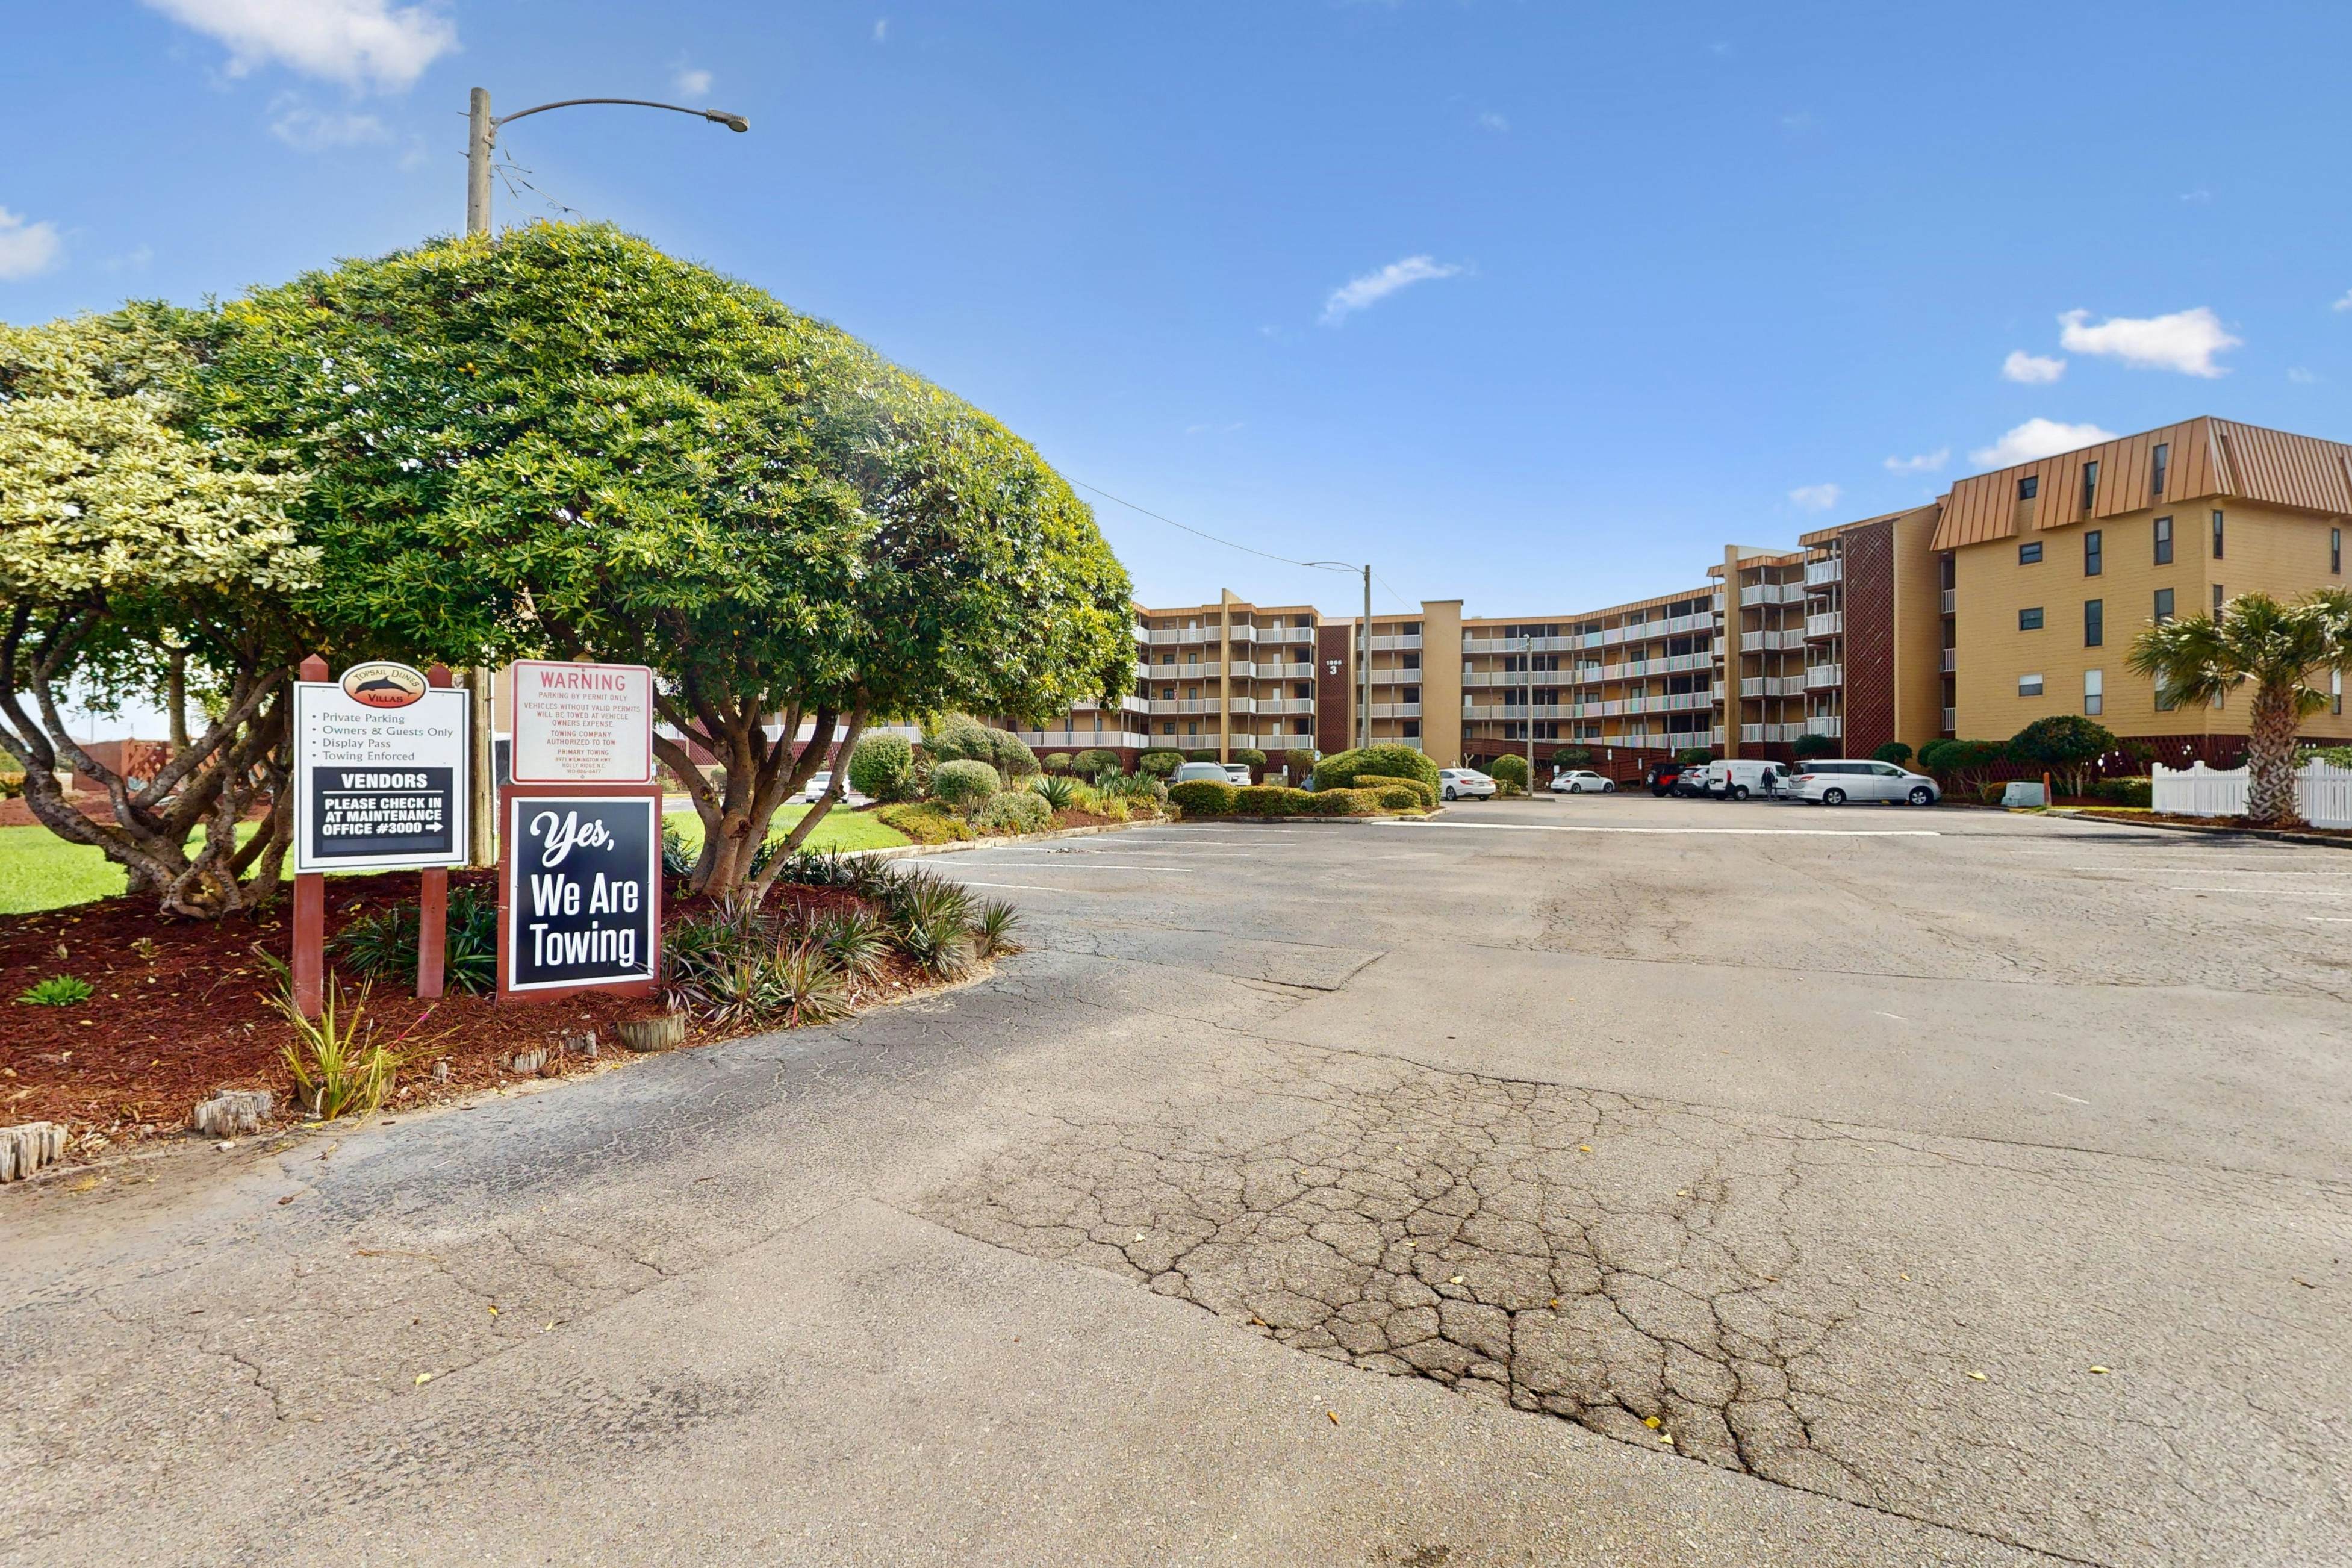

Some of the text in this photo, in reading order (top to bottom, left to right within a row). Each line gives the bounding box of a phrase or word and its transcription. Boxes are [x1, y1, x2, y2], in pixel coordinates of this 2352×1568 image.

[1330, 666, 1337, 674] 3
[353, 669, 419, 687] TOPSAIL DUNES
[541, 671, 625, 691] WARNING
[368, 694, 403, 703] VILLAS
[323, 712, 405, 724] Private Parking
[323, 725, 453, 738] Owners & Guests Only
[323, 739, 391, 749] Display Pass
[322, 751, 414, 762] Towing Enforced
[341, 773, 428, 788] VENDORS
[325, 797, 442, 810] PLEASE CHECK IN
[325, 810, 442, 823] AT MAINTENANCE
[322, 822, 422, 835] OFFICE #3000
[530, 811, 614, 868] Yes,
[530, 872, 638, 916] We Are
[529, 921, 635, 968] Towing
